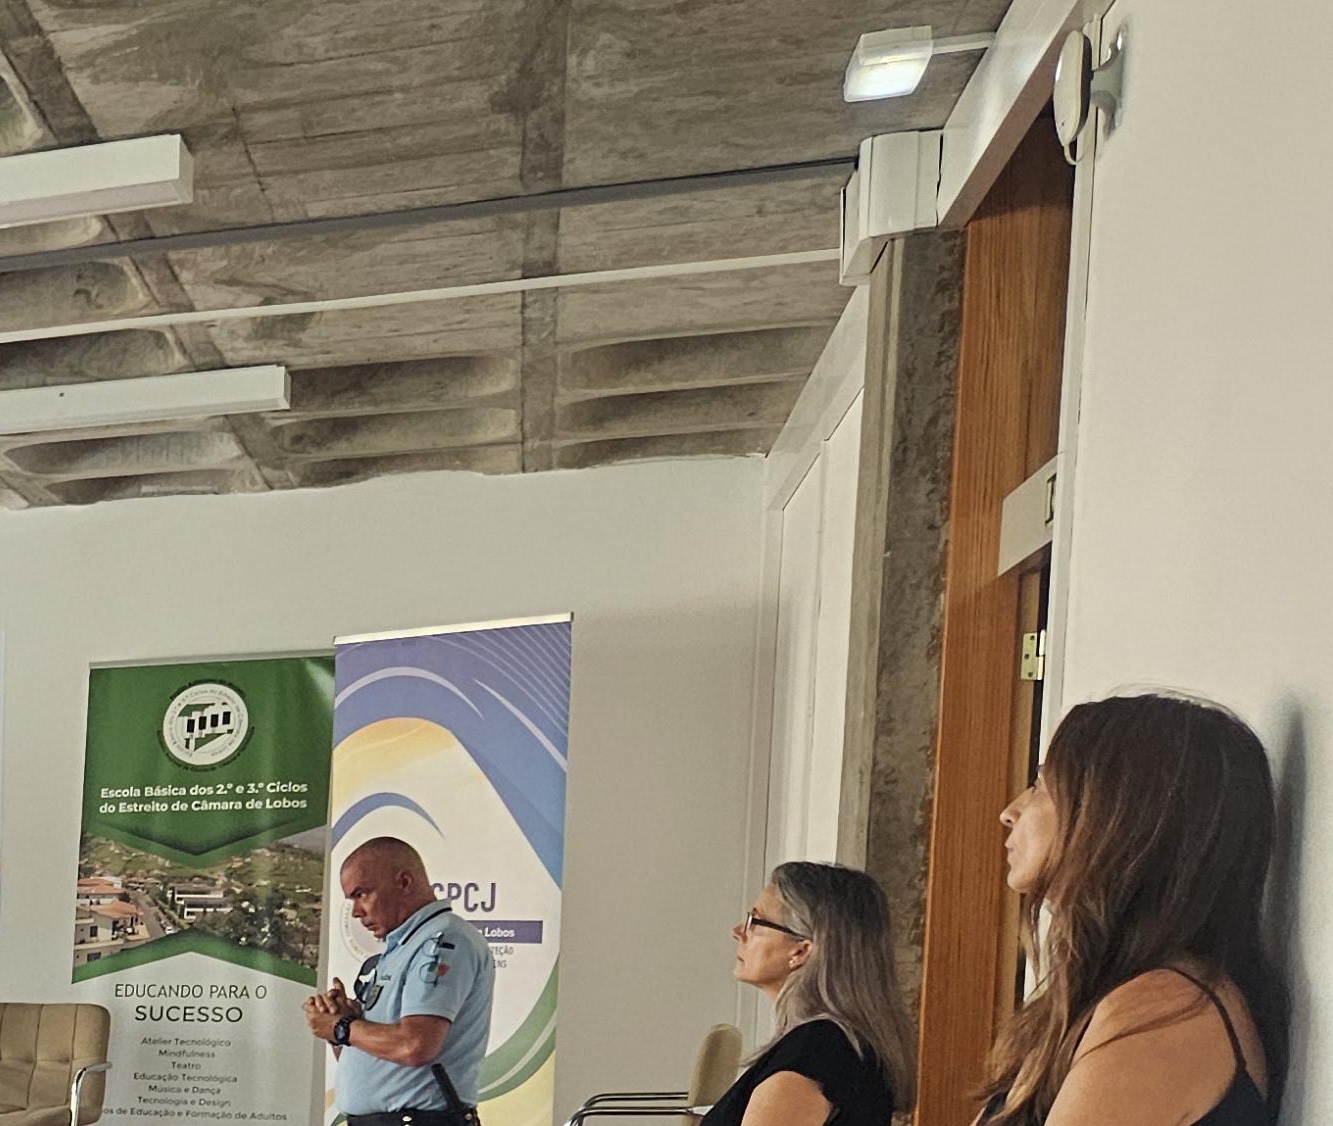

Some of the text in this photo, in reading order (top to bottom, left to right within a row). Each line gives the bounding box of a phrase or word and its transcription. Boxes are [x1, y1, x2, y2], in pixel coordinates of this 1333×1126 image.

[100, 786, 141, 798] Escola
[144, 784, 187, 797] Básica
[189, 784, 214, 796] dos
[235, 785, 245, 794] e
[266, 781, 309, 793] Ciclos
[99, 797, 308, 814] do Estreito de Câmara de Lobos
[484, 926, 515, 938] Lobos
[114, 983, 268, 1000] EDUCANDO PARA O
[134, 1005, 243, 1023] SUCESSO
[141, 1037, 232, 1048] Atelier Tecnológico
[158, 1049, 216, 1059] Mindfulness
[171, 1061, 202, 1071] Teatro
[133, 1072, 238, 1085] Educação Tecnológica
[148, 1085, 183, 1094] Música
[192, 1086, 222, 1096] Dança
[137, 1096, 189, 1107] Tecnologia
[198, 1098, 232, 1108] Design
[115, 1107, 128, 1115] de
[130, 1107, 176, 1118] Educação
[185, 1110, 233, 1120] Formação
[234, 1111, 248, 1120] de
[249, 1112, 287, 1121] Adultos
